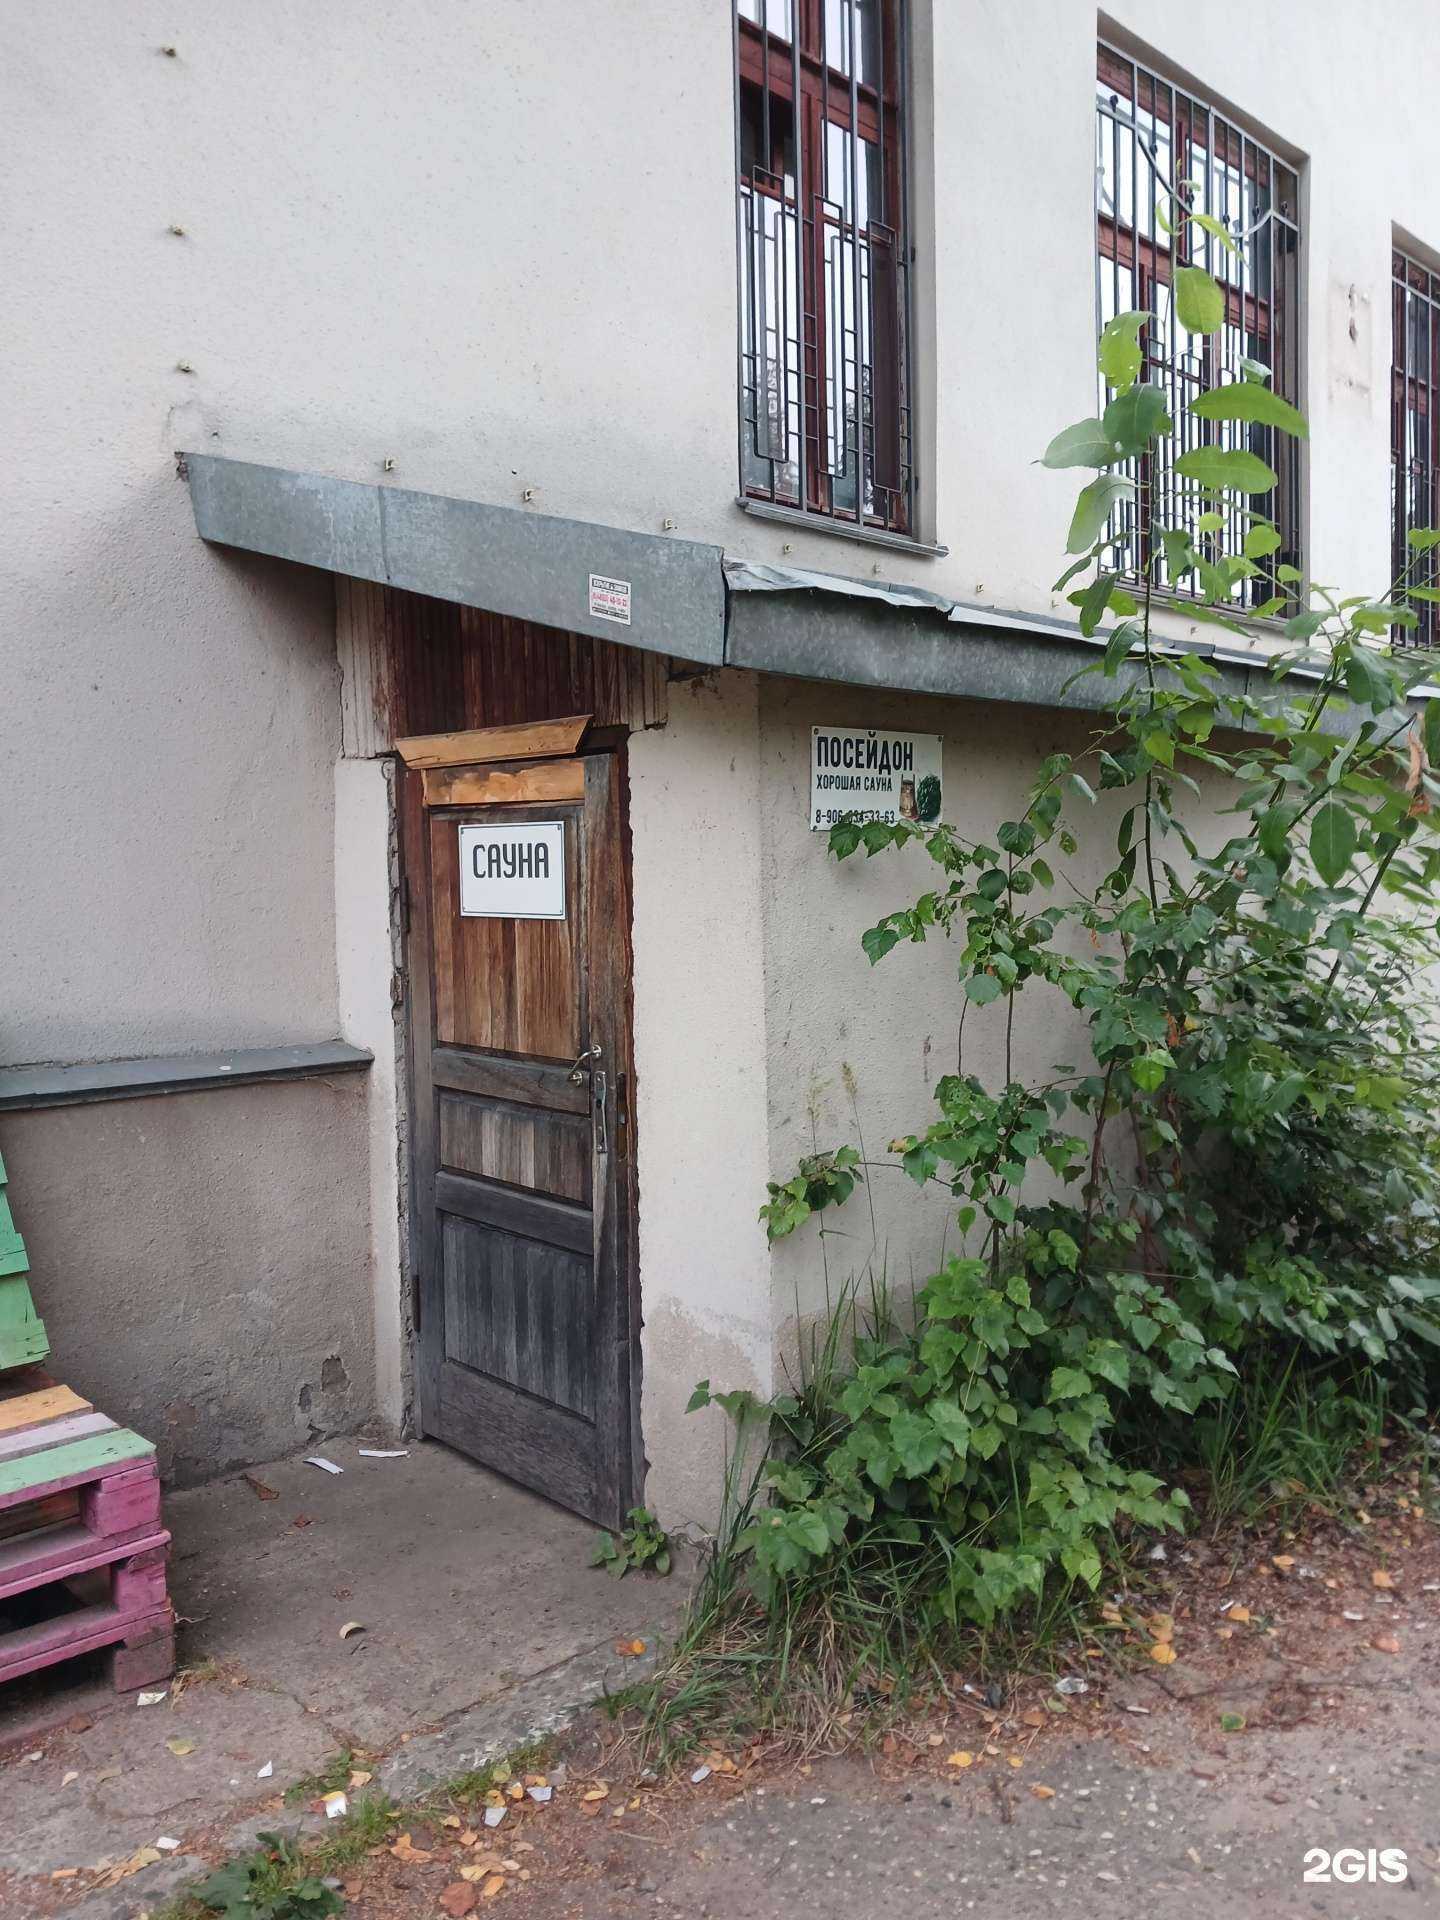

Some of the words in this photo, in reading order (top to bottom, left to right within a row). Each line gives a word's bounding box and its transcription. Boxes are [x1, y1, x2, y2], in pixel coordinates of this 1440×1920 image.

[817, 730, 913, 775] ПОСЕЙДОН
[816, 774, 861, 791] ХОРОШАЯ
[864, 776, 893, 792] САУНА
[473, 843, 549, 878] САУНА
